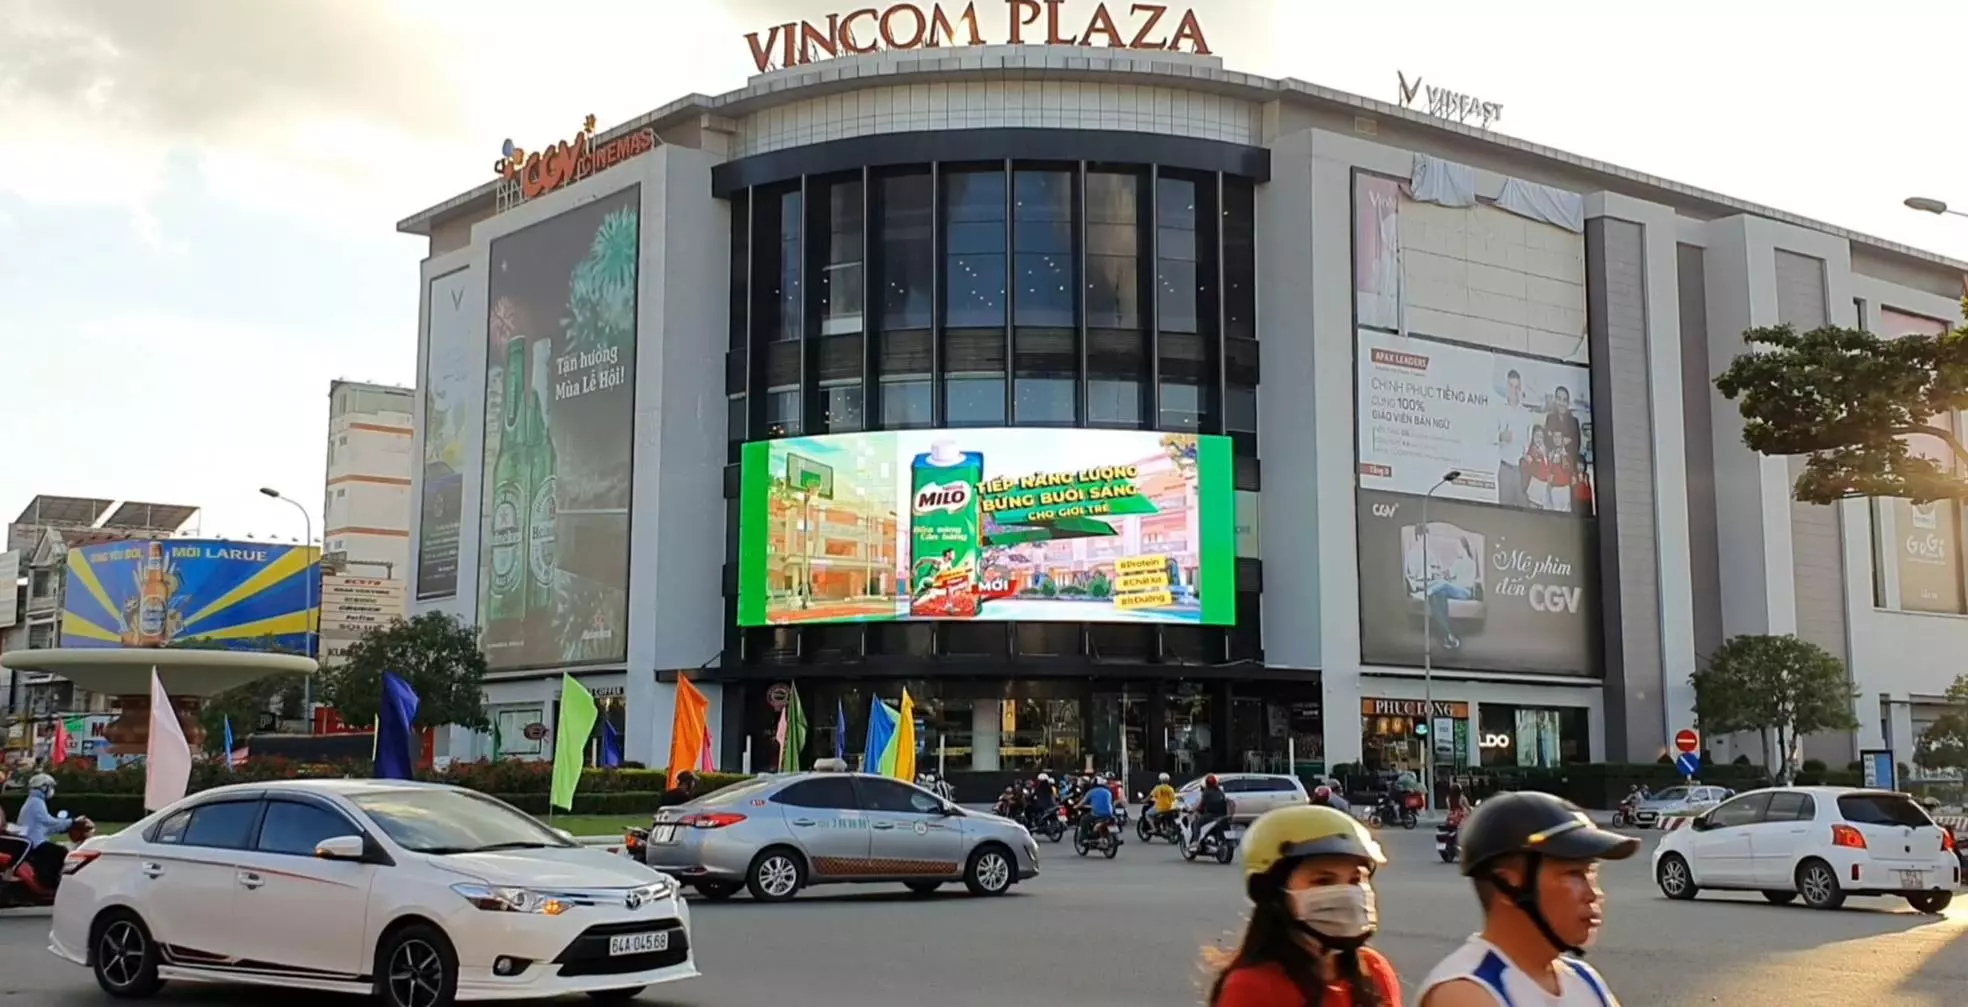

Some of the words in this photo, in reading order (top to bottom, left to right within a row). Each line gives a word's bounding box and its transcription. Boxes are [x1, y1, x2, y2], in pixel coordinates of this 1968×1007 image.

[744, 0, 987, 73] VINCOM
[1006, 0, 1214, 55] PLAZA
[1425, 85, 1504, 121] VINFAST
[522, 131, 585, 198] CGV
[578, 129, 655, 176] CINEMAS
[1375, 351, 1395, 363] APAX
[1395, 353, 1427, 368] LEADERS
[555, 378, 580, 400] Mùa
[599, 366, 625, 391] Hội!
[1397, 397, 1426, 413] 100%
[1467, 392, 1489, 406] ANH
[976, 475, 1016, 494] TIẾP
[1078, 464, 1139, 484] LƯỢNG
[918, 490, 965, 507] MILO
[1090, 480, 1138, 499] SÁNG
[1027, 509, 1055, 521] CHO
[1372, 503, 1397, 518] CGV
[205, 547, 268, 562] LARUE
[1492, 549, 1532, 575] Mê
[1532, 555, 1572, 580] phim
[1529, 585, 1583, 614] CGV
